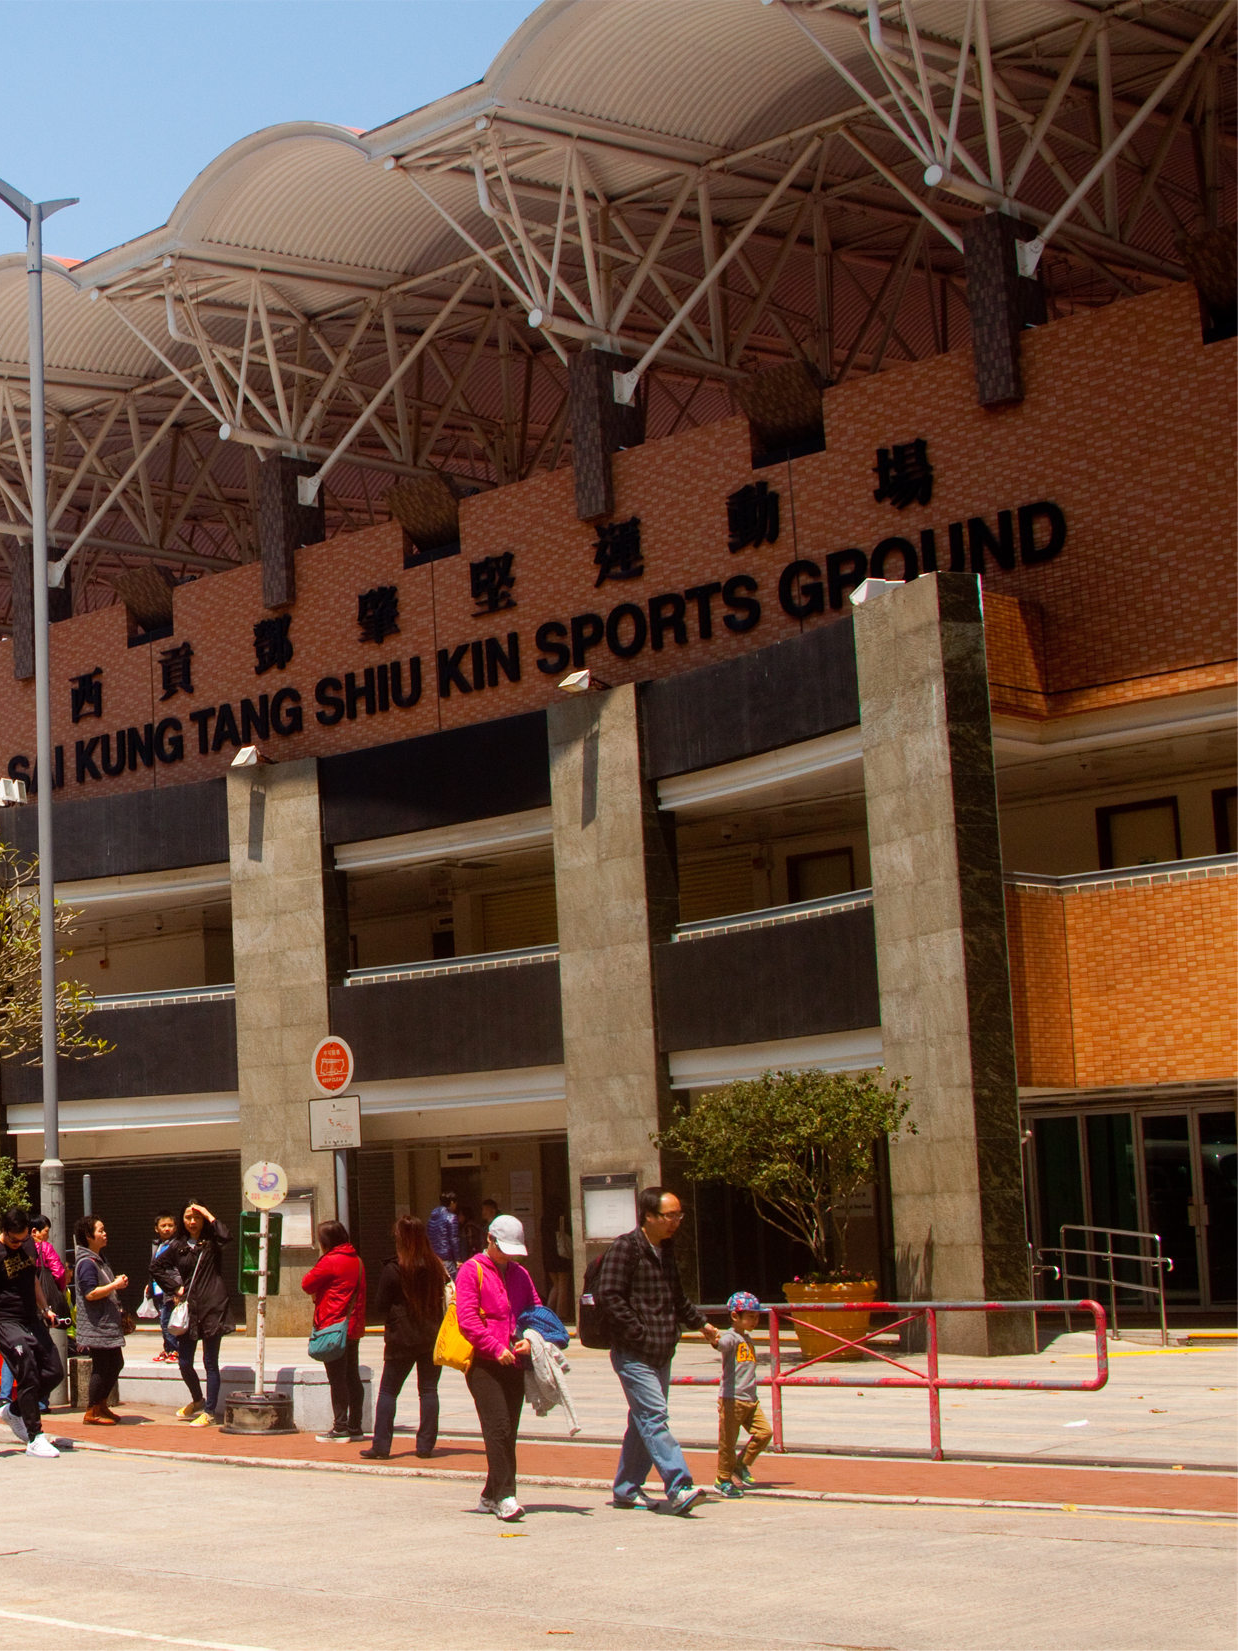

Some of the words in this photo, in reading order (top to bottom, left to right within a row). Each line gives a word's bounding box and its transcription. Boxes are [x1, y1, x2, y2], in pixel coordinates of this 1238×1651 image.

[76, 717, 184, 783] KUNG
[189, 687, 303, 754] TANG
[315, 656, 421, 726] SHIU
[438, 632, 520, 698] KIN
[536, 574, 761, 675] SPORTS
[778, 501, 1067, 618] GROUND
